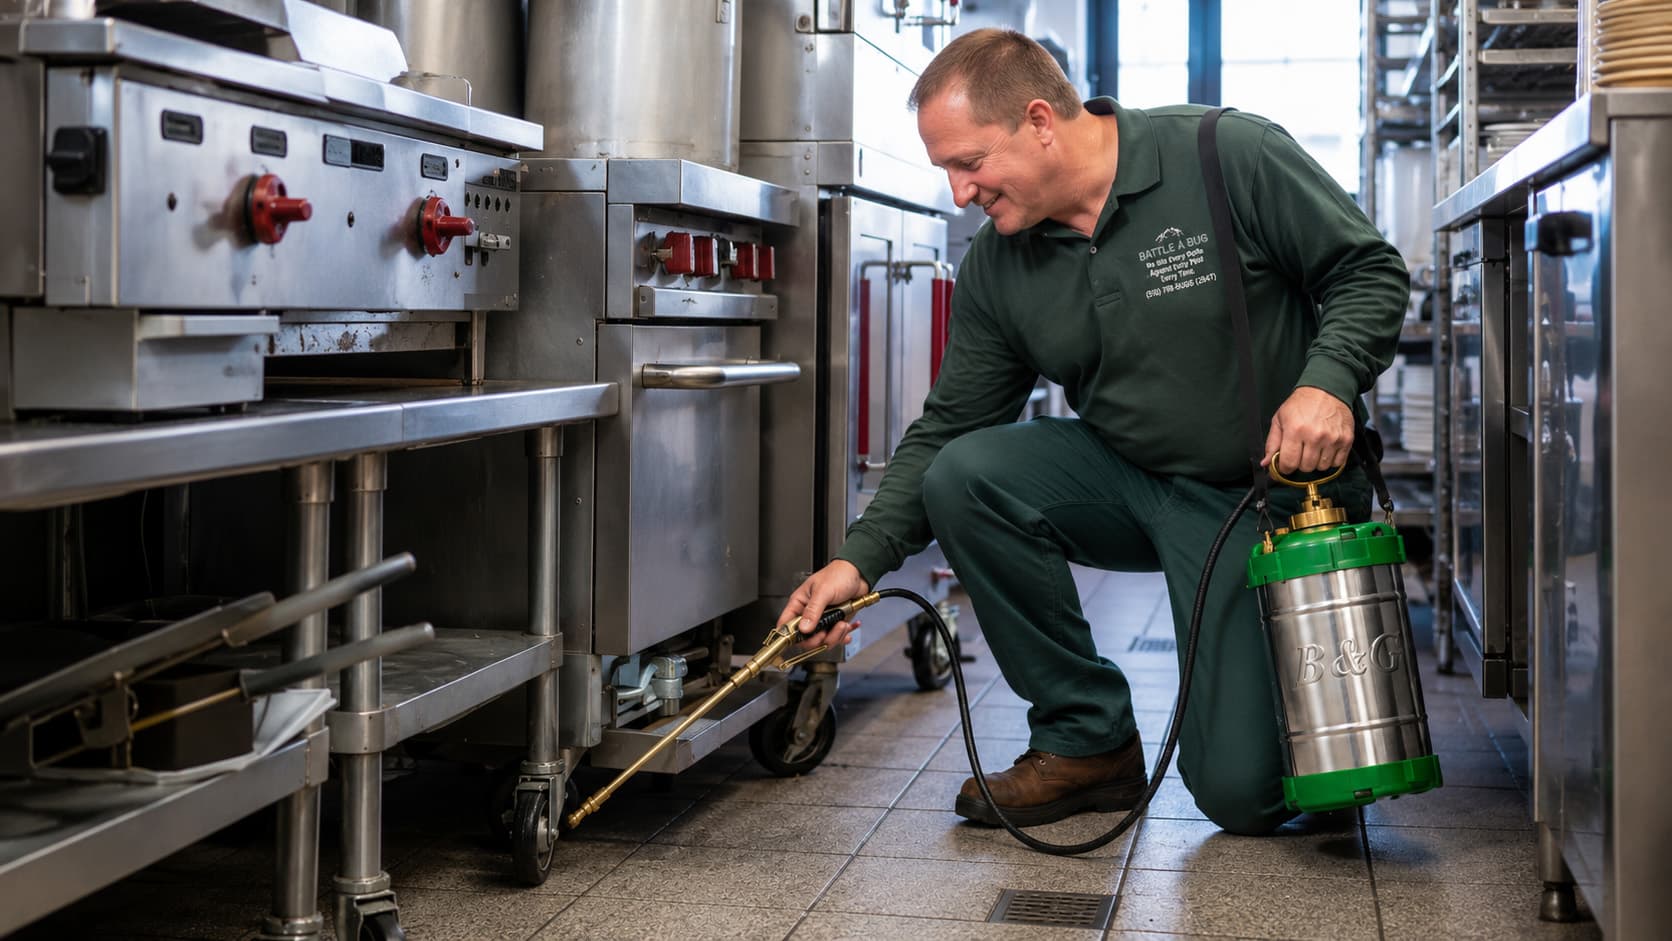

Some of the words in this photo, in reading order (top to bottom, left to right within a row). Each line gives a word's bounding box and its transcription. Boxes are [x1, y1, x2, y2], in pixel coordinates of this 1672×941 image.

[1138, 242, 1176, 261] BATTLE
[1178, 240, 1186, 250] A
[1186, 233, 1209, 247] BUG
